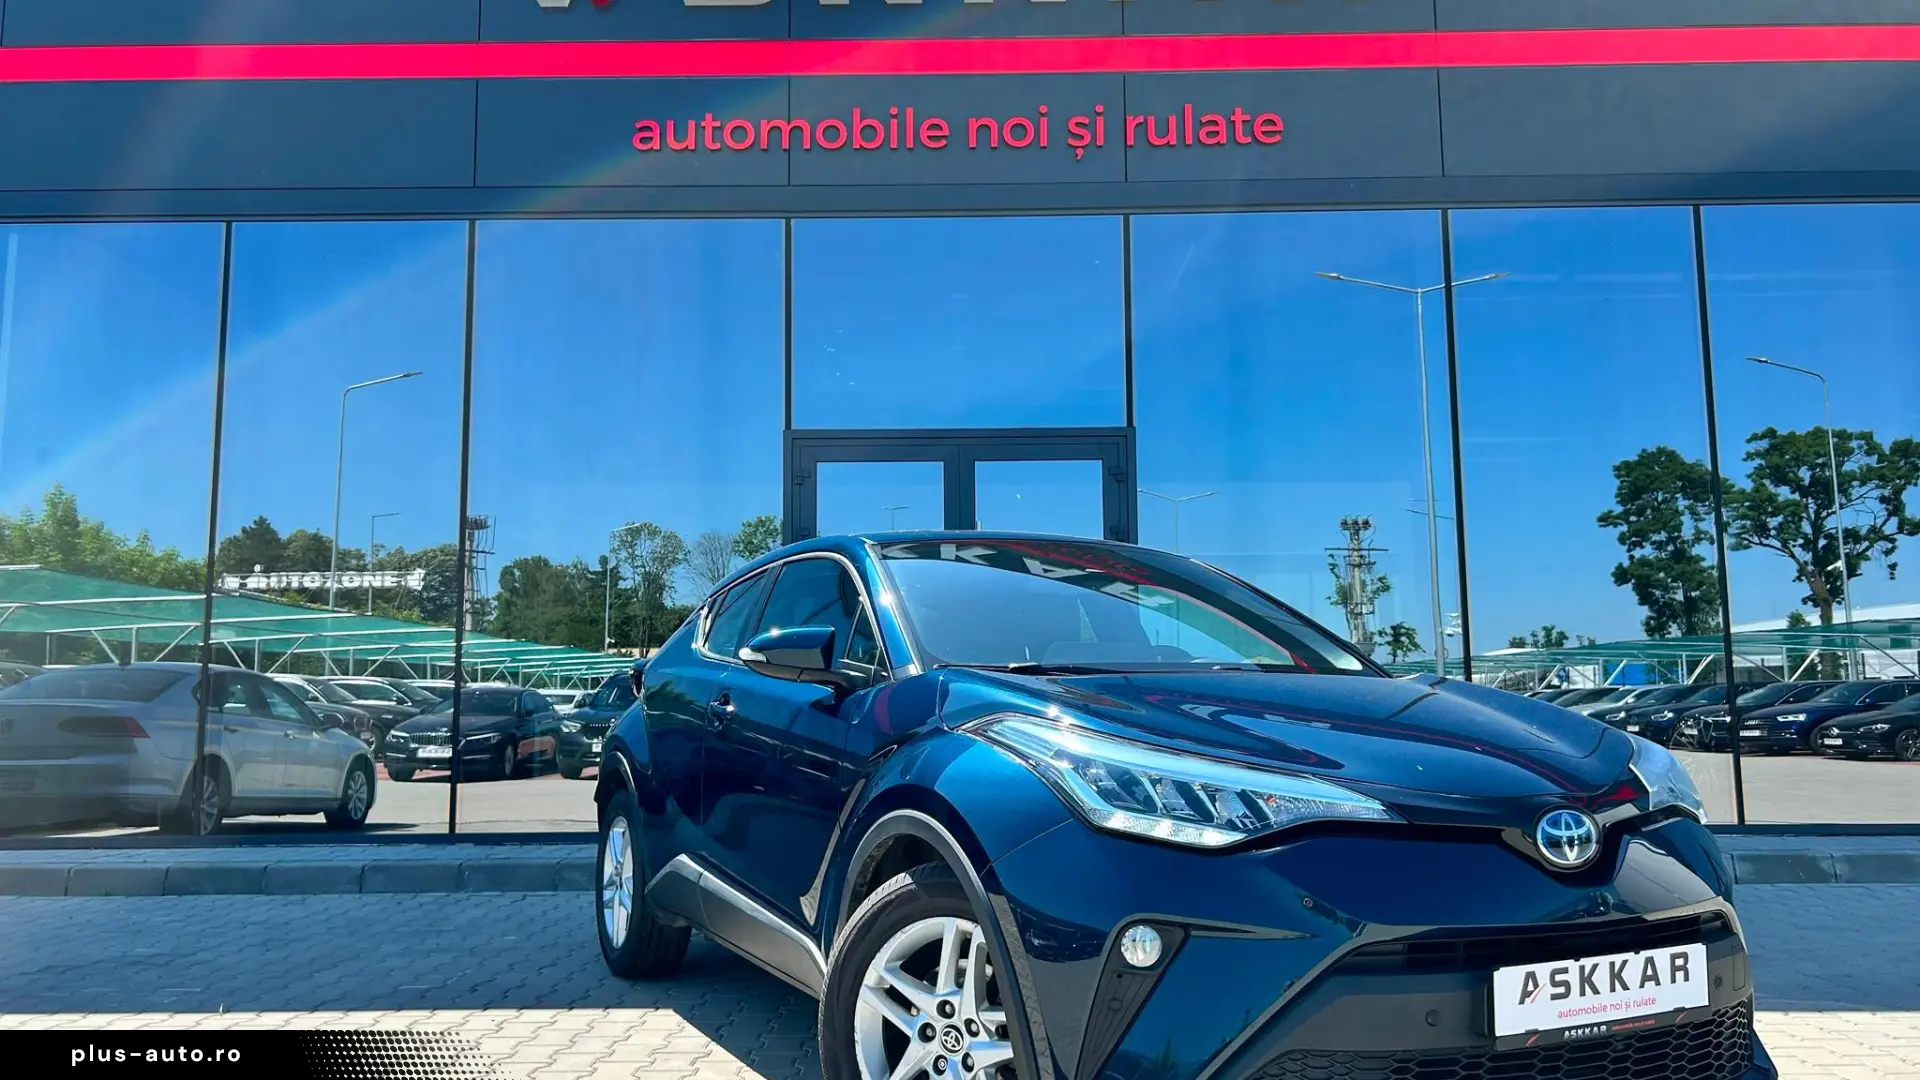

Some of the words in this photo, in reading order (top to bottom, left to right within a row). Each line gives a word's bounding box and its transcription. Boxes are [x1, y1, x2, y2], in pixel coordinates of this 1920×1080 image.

[632, 107, 950, 151] automobile
[968, 105, 1048, 148] noi
[1067, 104, 1104, 161] și
[1125, 103, 1284, 147] rulate
[1518, 951, 1690, 1005] ASKKAR
[1557, 1002, 1608, 1019] automobile
[1609, 1000, 1623, 1012] noi
[1632, 996, 1657, 1009] rulate
[1563, 1025, 1607, 1040] ASKKAR
